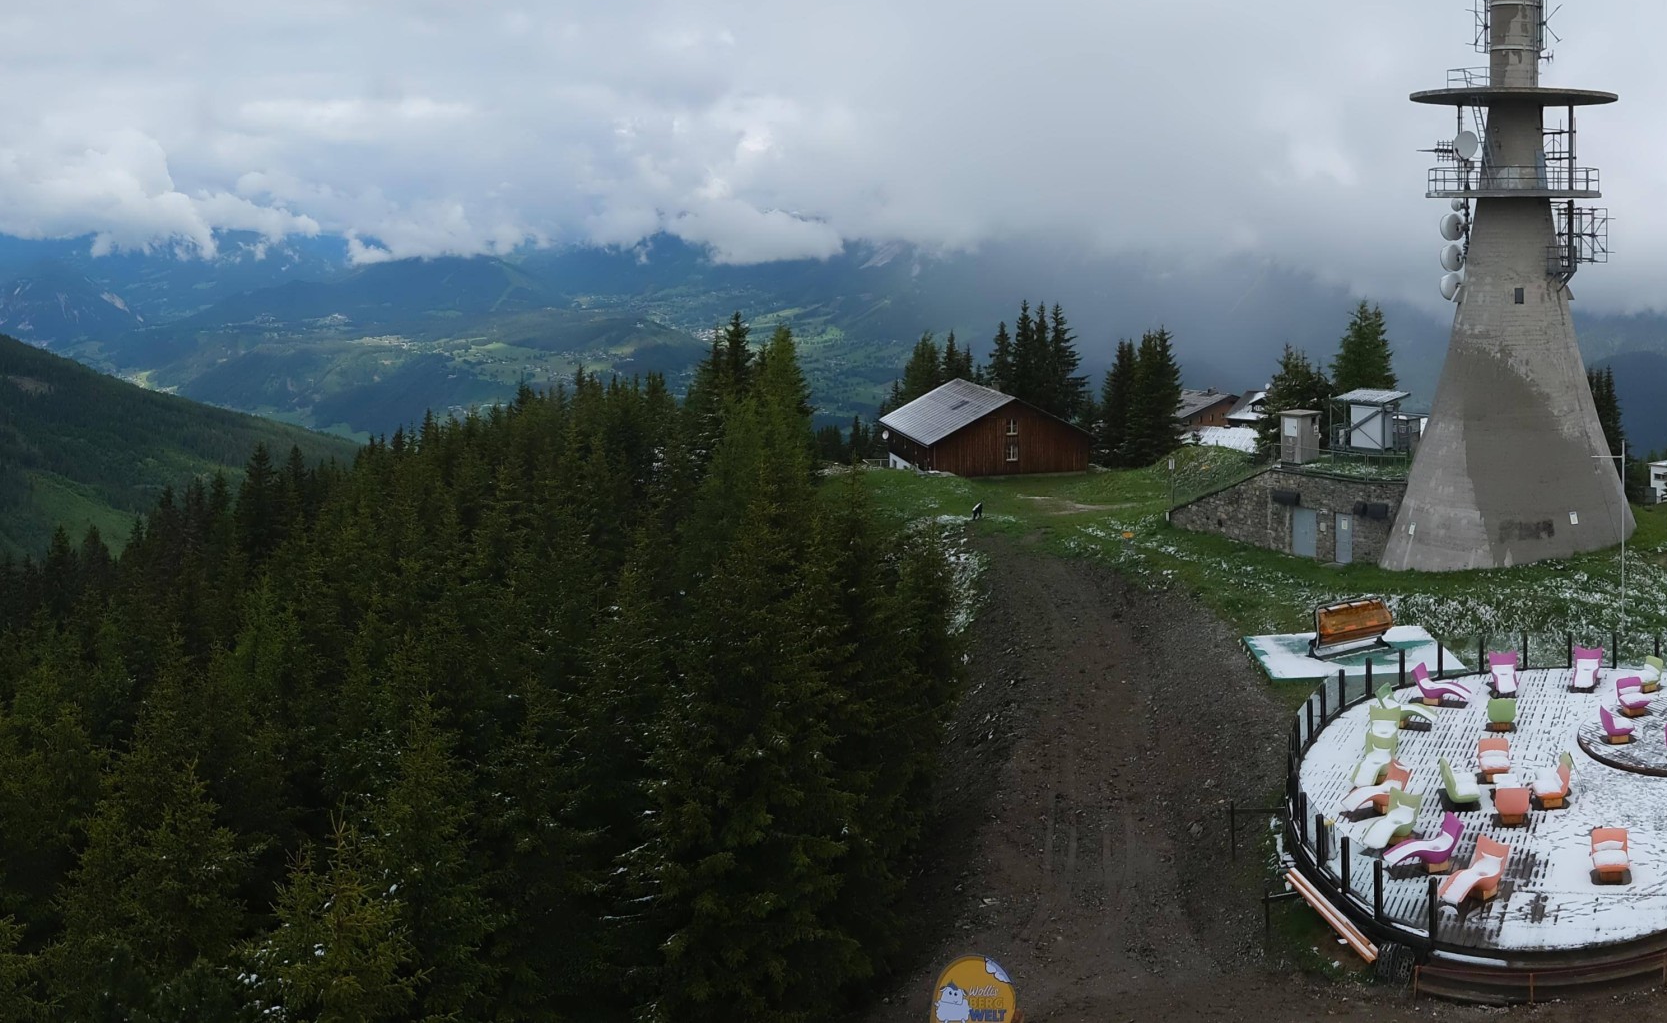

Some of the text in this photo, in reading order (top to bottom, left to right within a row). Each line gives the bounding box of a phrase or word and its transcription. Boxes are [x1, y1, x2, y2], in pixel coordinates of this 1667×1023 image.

[968, 985, 999, 996] Wollis
[969, 997, 1004, 1008] BERG
[968, 1009, 1007, 1022] WELT
